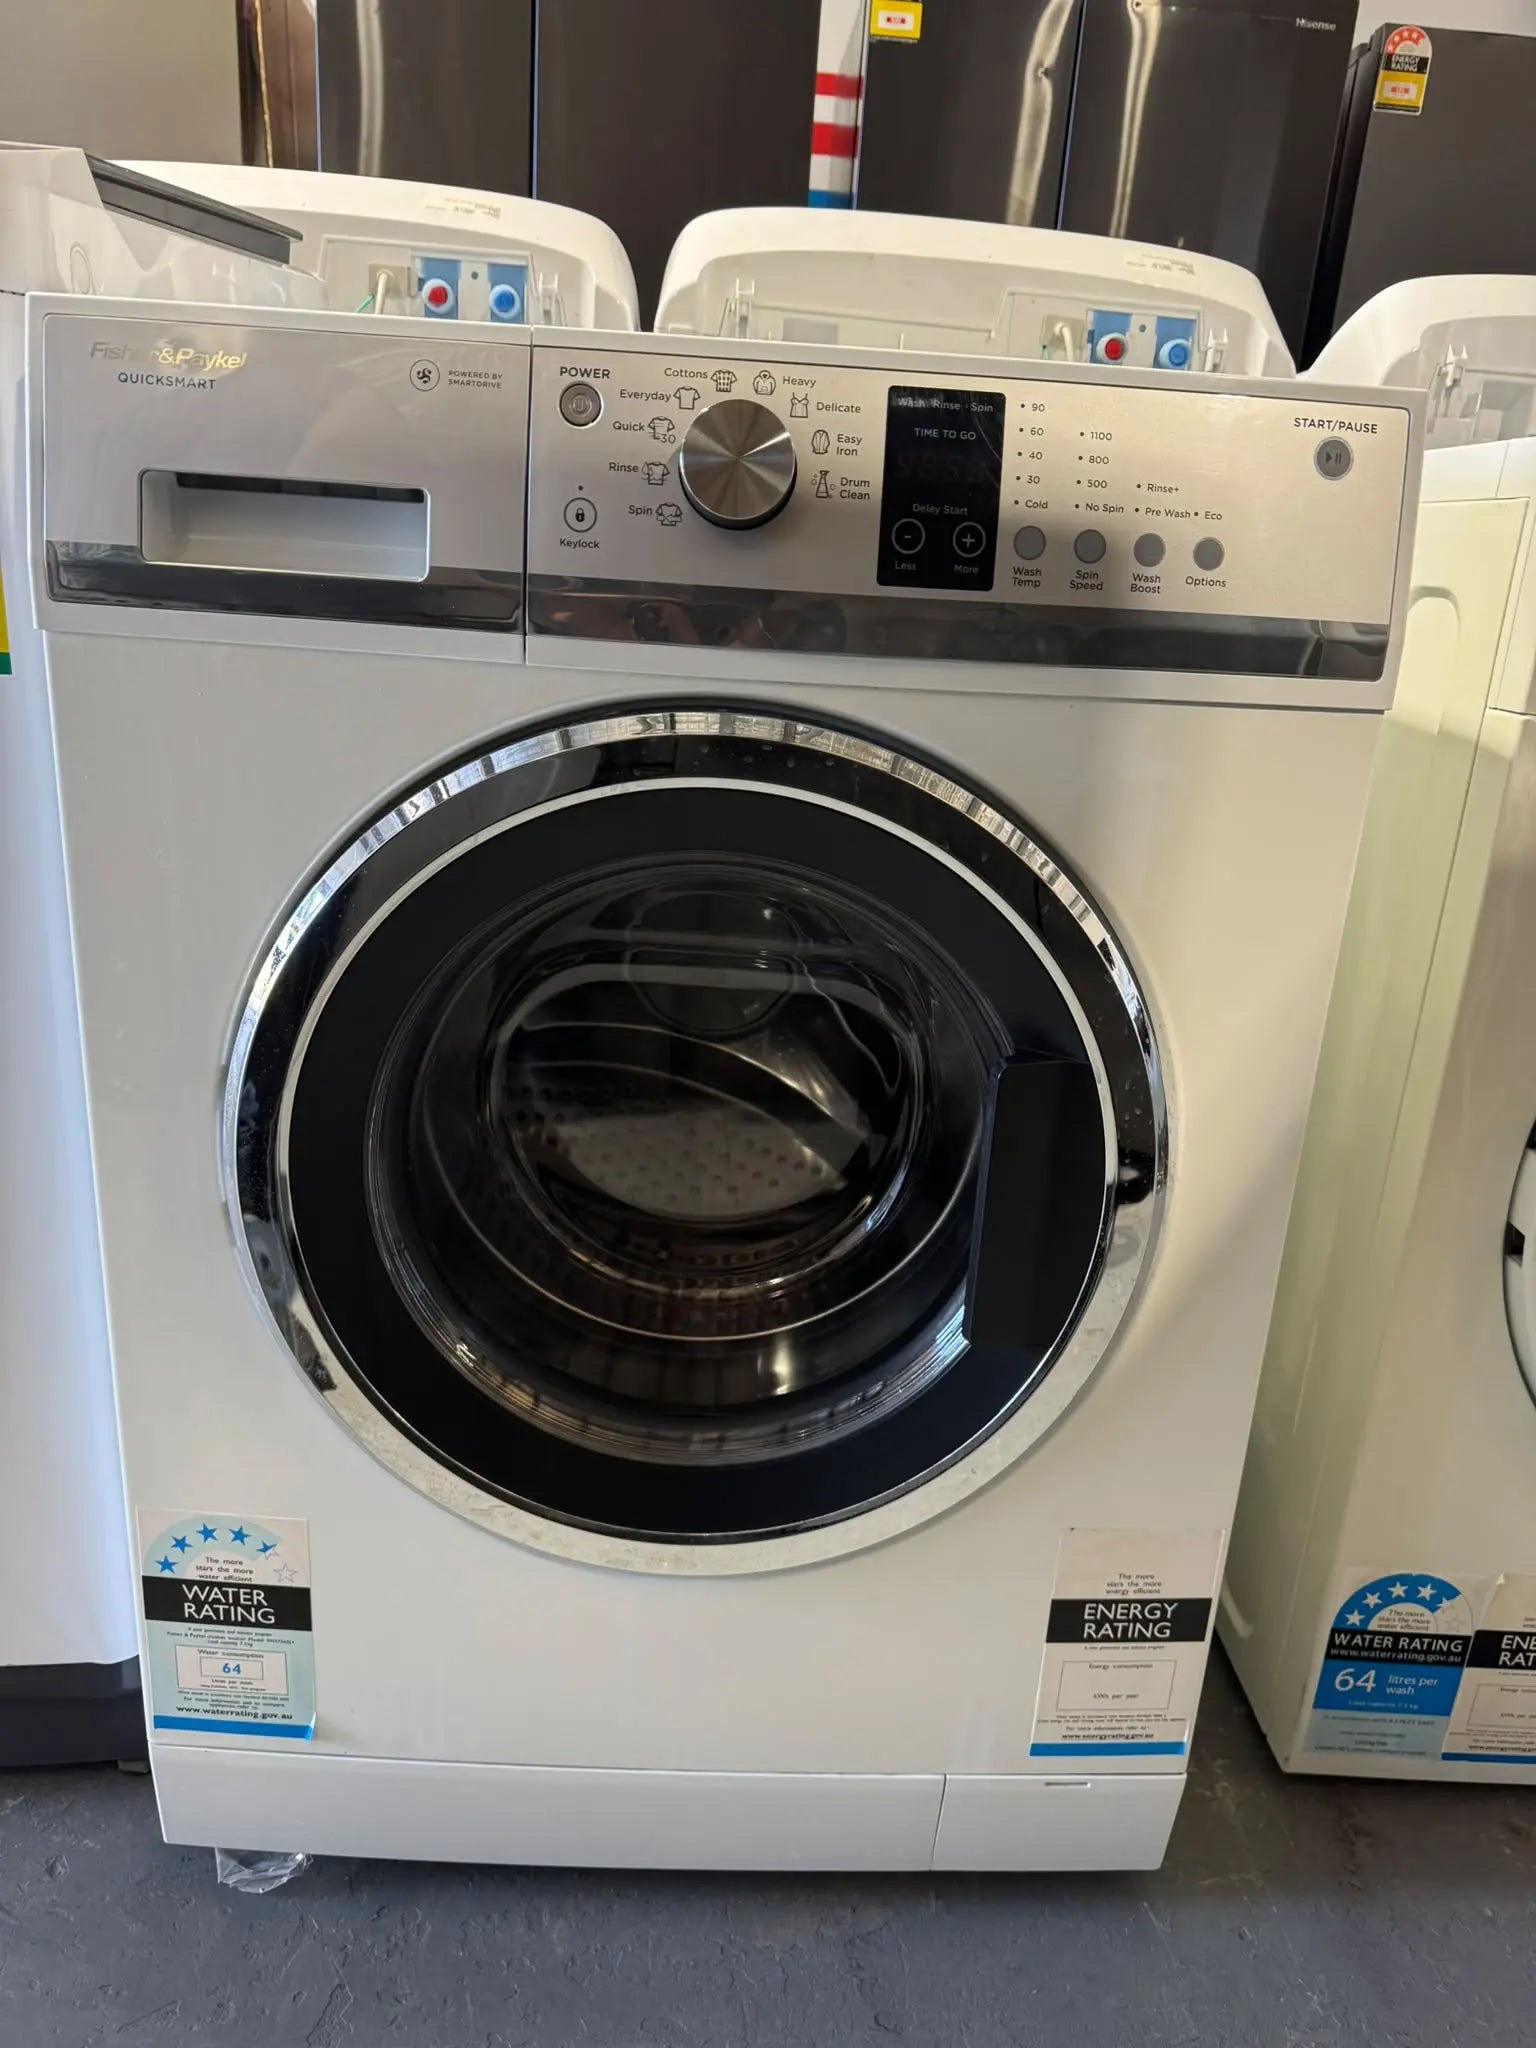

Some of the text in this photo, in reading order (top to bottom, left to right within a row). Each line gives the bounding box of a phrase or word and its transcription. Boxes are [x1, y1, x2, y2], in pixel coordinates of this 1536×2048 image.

[1296, 18, 1336, 31] Hisense
[1391, 63, 1418, 72] RATING
[448, 370, 503, 380] POWERED BY
[559, 366, 611, 379] POWER
[664, 367, 708, 379] Cottons
[118, 372, 217, 390] QUICKSMART
[448, 379, 503, 389] SMARTDRIVE
[782, 376, 817, 388] Heavy
[619, 389, 672, 403] Everyday
[816, 402, 862, 414] Delicate
[898, 397, 994, 413] Wash Rinse Spin
[1031, 403, 1046, 412] 90
[1030, 427, 1044, 436] 60
[1293, 417, 1379, 434] START/PAUSE
[612, 421, 677, 444] Quick 30
[914, 427, 977, 441] TIME TO GO
[1090, 431, 1113, 441] 1100
[837, 434, 863, 446] Easy
[836, 446, 859, 457] Iron
[1029, 451, 1043, 460] 40
[1088, 455, 1110, 465] 800
[608, 462, 639, 473] Rinse
[840, 477, 871, 488] Drum
[1026, 475, 1041, 485] 30
[1087, 479, 1108, 489] 500
[840, 489, 871, 500] Clean
[1147, 483, 1180, 494] Rinse+
[912, 503, 968, 516] Delay Start
[1025, 499, 1049, 509] Cold
[1085, 503, 1124, 514] No Spin
[628, 504, 653, 517] Spin
[1145, 507, 1191, 519] Pre Wash
[1204, 511, 1223, 521] Eco
[559, 537, 601, 550] Keylock
[894, 561, 918, 571] Less
[953, 564, 979, 574] More
[1012, 566, 1042, 577] Wash
[1075, 570, 1099, 581] Spin
[1132, 573, 1161, 584] Wash
[1012, 577, 1041, 589] Temp
[1069, 580, 1104, 592] Speed
[1185, 576, 1227, 588] Options
[1130, 583, 1161, 594] Boost
[181, 1584, 268, 1606] WATER
[183, 1602, 276, 1624] RATING
[1083, 1602, 1179, 1620] ENERGY
[1083, 1621, 1172, 1639] RATING
[1334, 1633, 1464, 1653] WATER RATING
[1330, 1647, 1462, 1662] www.waterrating.gov.au
[222, 1662, 242, 1675] 64
[1334, 1668, 1439, 1692] 64 litres per
[1385, 1686, 1415, 1695] wash
[176, 1705, 294, 1720] www.waterrating.gov.au
